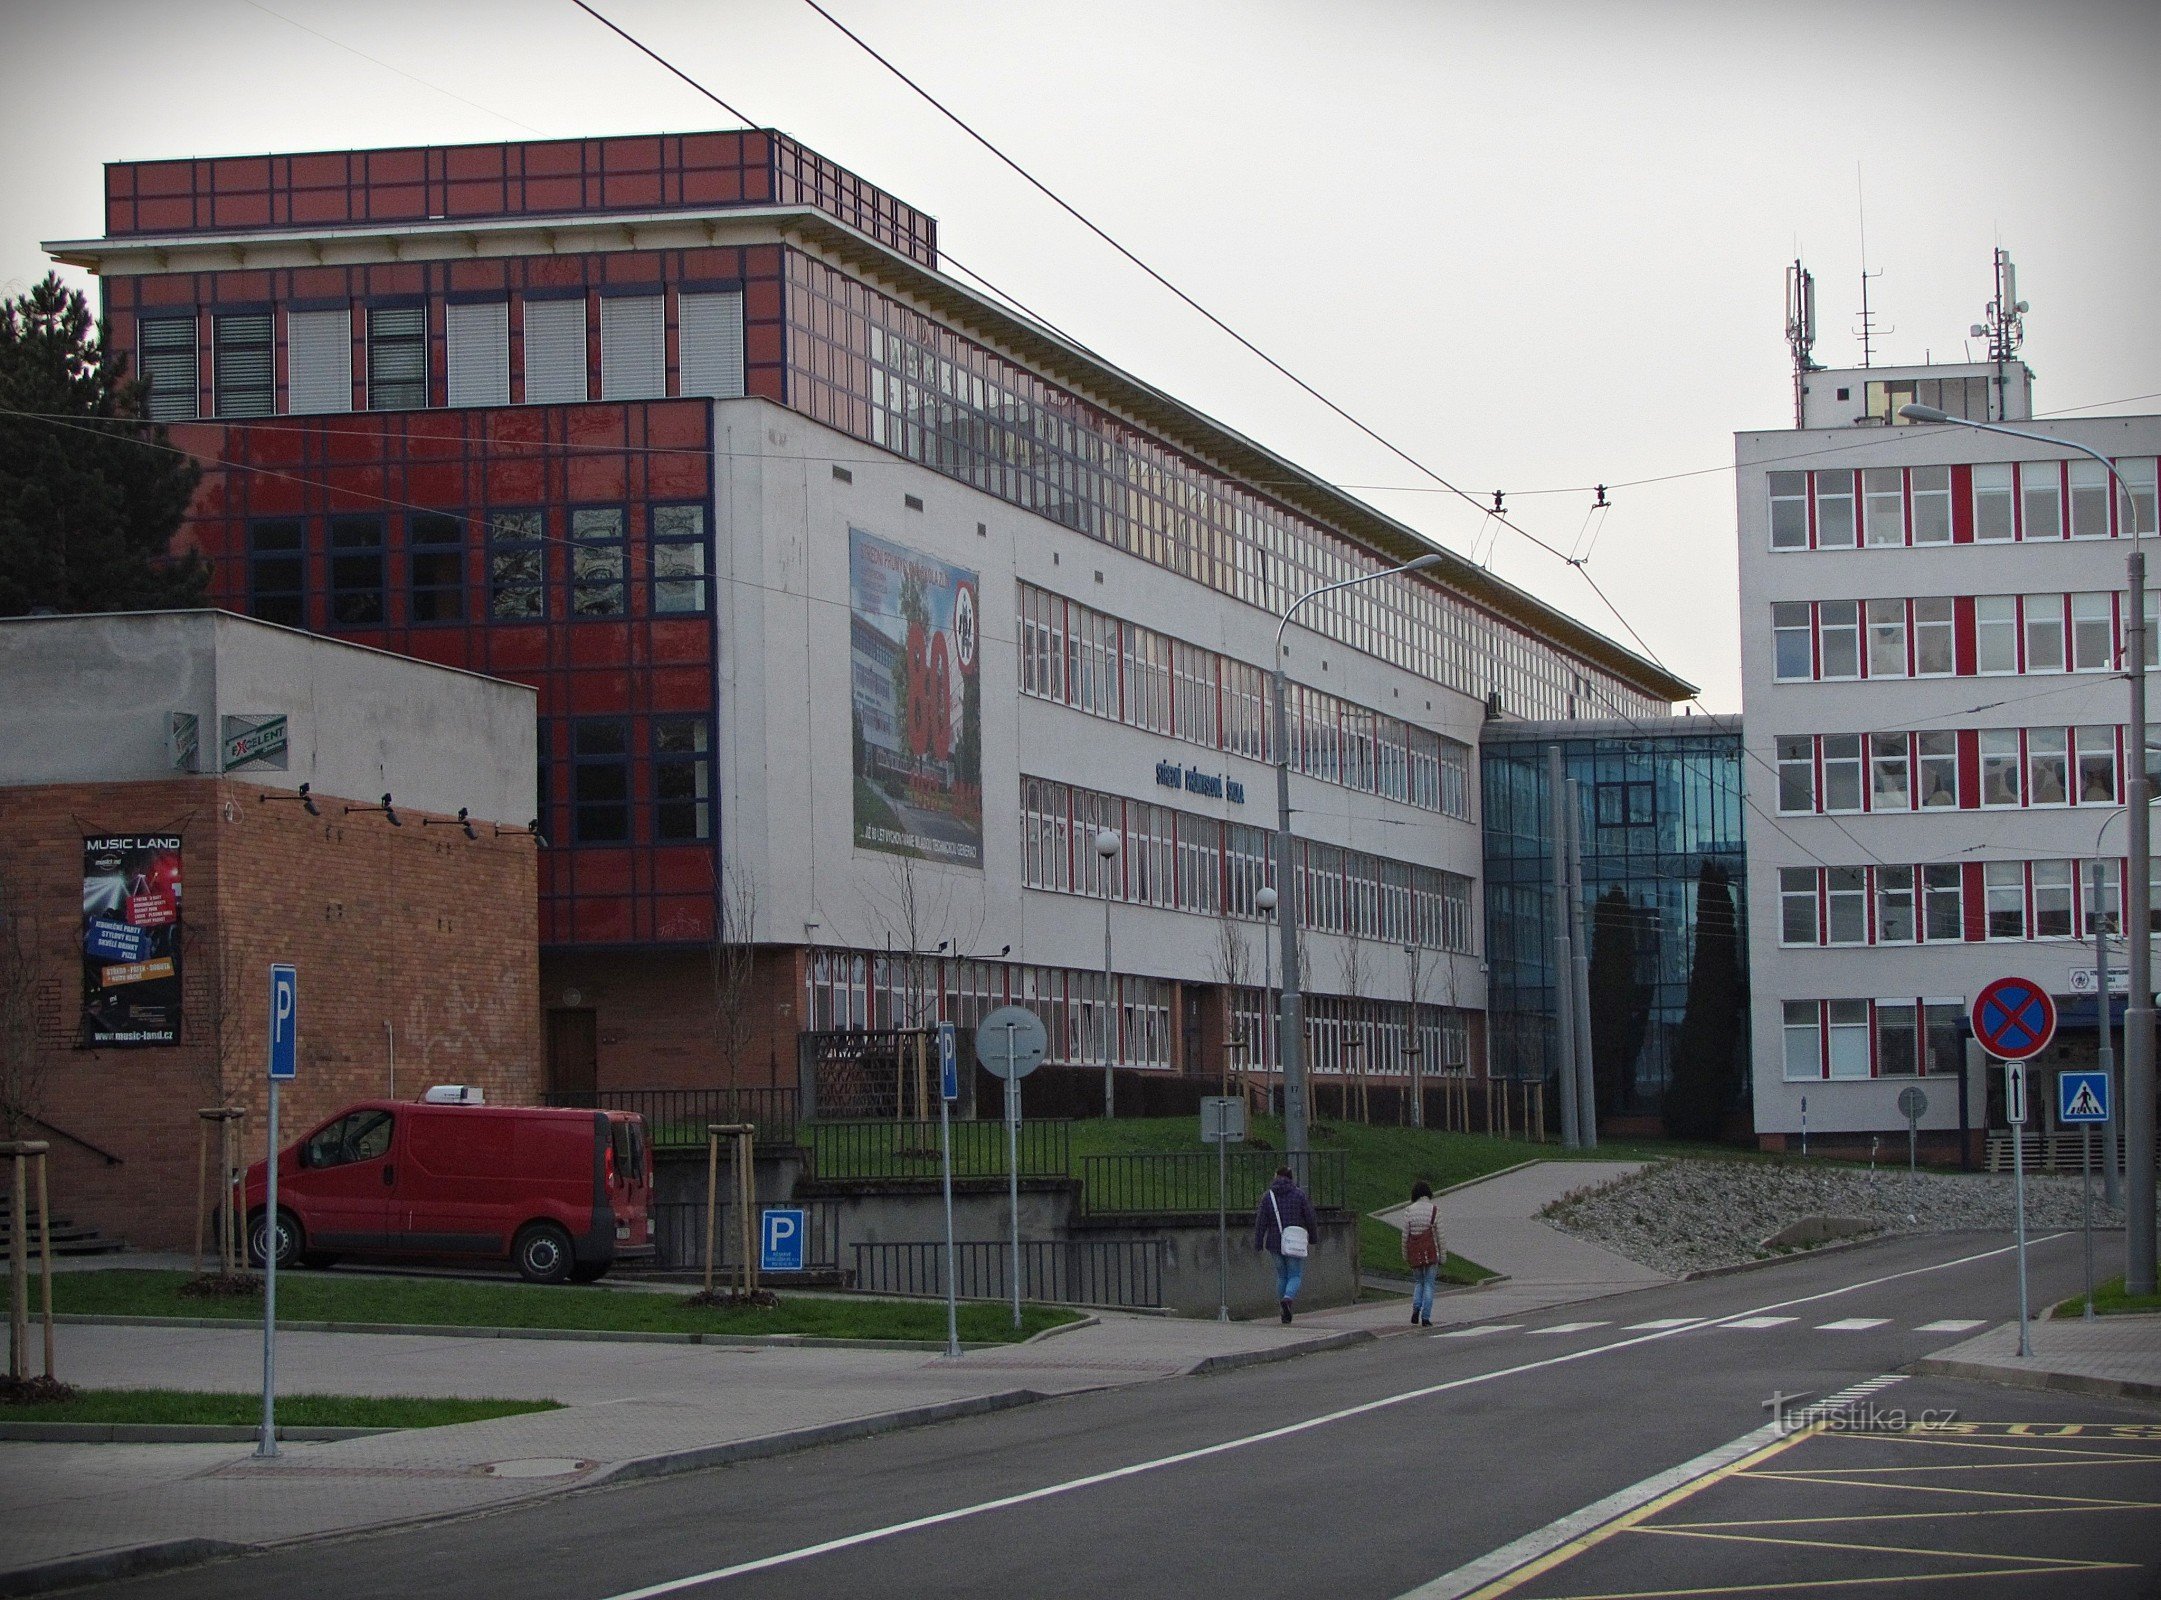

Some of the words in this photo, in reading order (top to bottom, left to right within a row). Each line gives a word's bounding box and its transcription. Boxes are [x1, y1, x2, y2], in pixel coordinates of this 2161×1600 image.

[906, 621, 951, 762] 80
[232, 727, 285, 757] EXCELENT
[87, 838, 133, 850] MUSIC
[137, 838, 180, 849] LAND
[123, 924, 141, 934] PARTY
[121, 951, 137, 960] PIZZA
[276, 981, 292, 1043] P
[94, 1030, 173, 1041] www.music-land.cz
[944, 1033, 953, 1076] P
[771, 1217, 794, 1251] P
